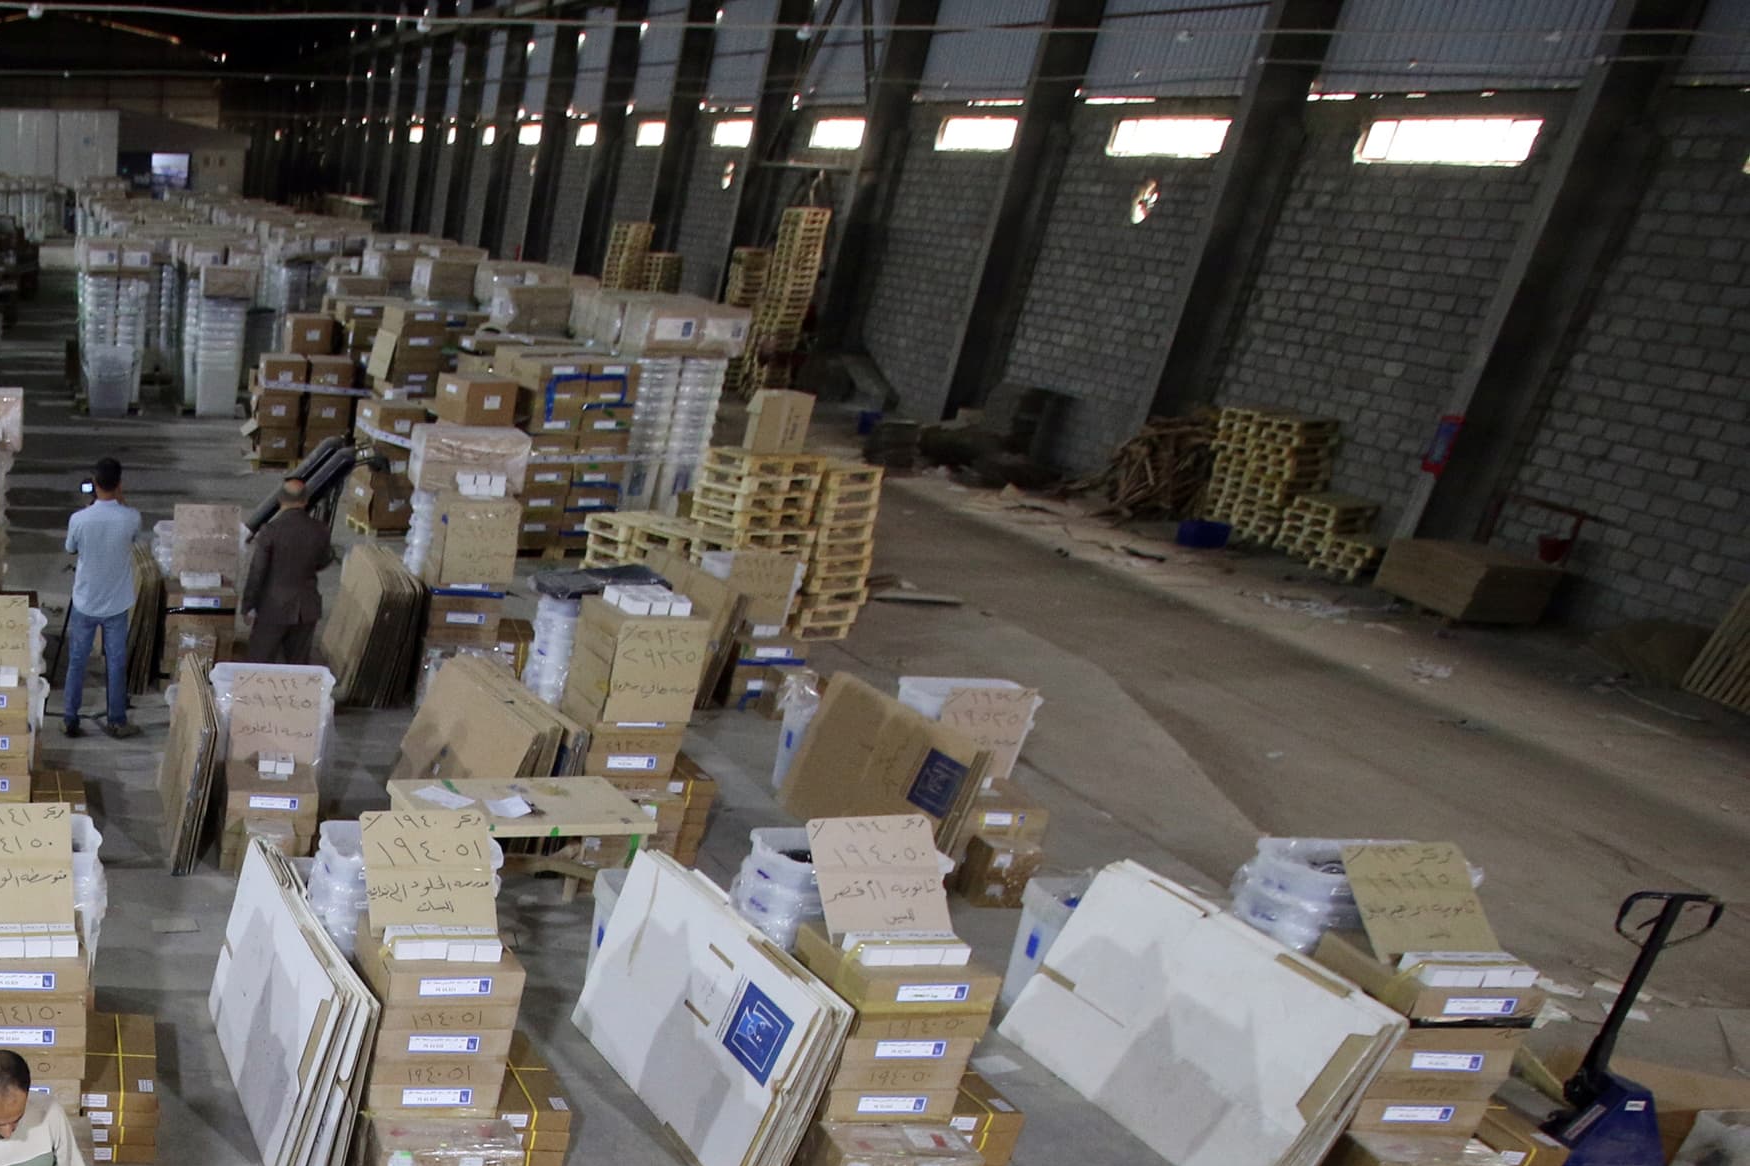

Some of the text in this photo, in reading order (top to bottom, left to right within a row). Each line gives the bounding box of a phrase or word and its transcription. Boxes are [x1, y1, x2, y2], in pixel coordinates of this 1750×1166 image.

[376, 837, 483, 867] ١٩٤٠٥١
[411, 1010, 483, 1027] ١٩٤٠٥١
[407, 1065, 471, 1083] ١٩٤٠٥١
